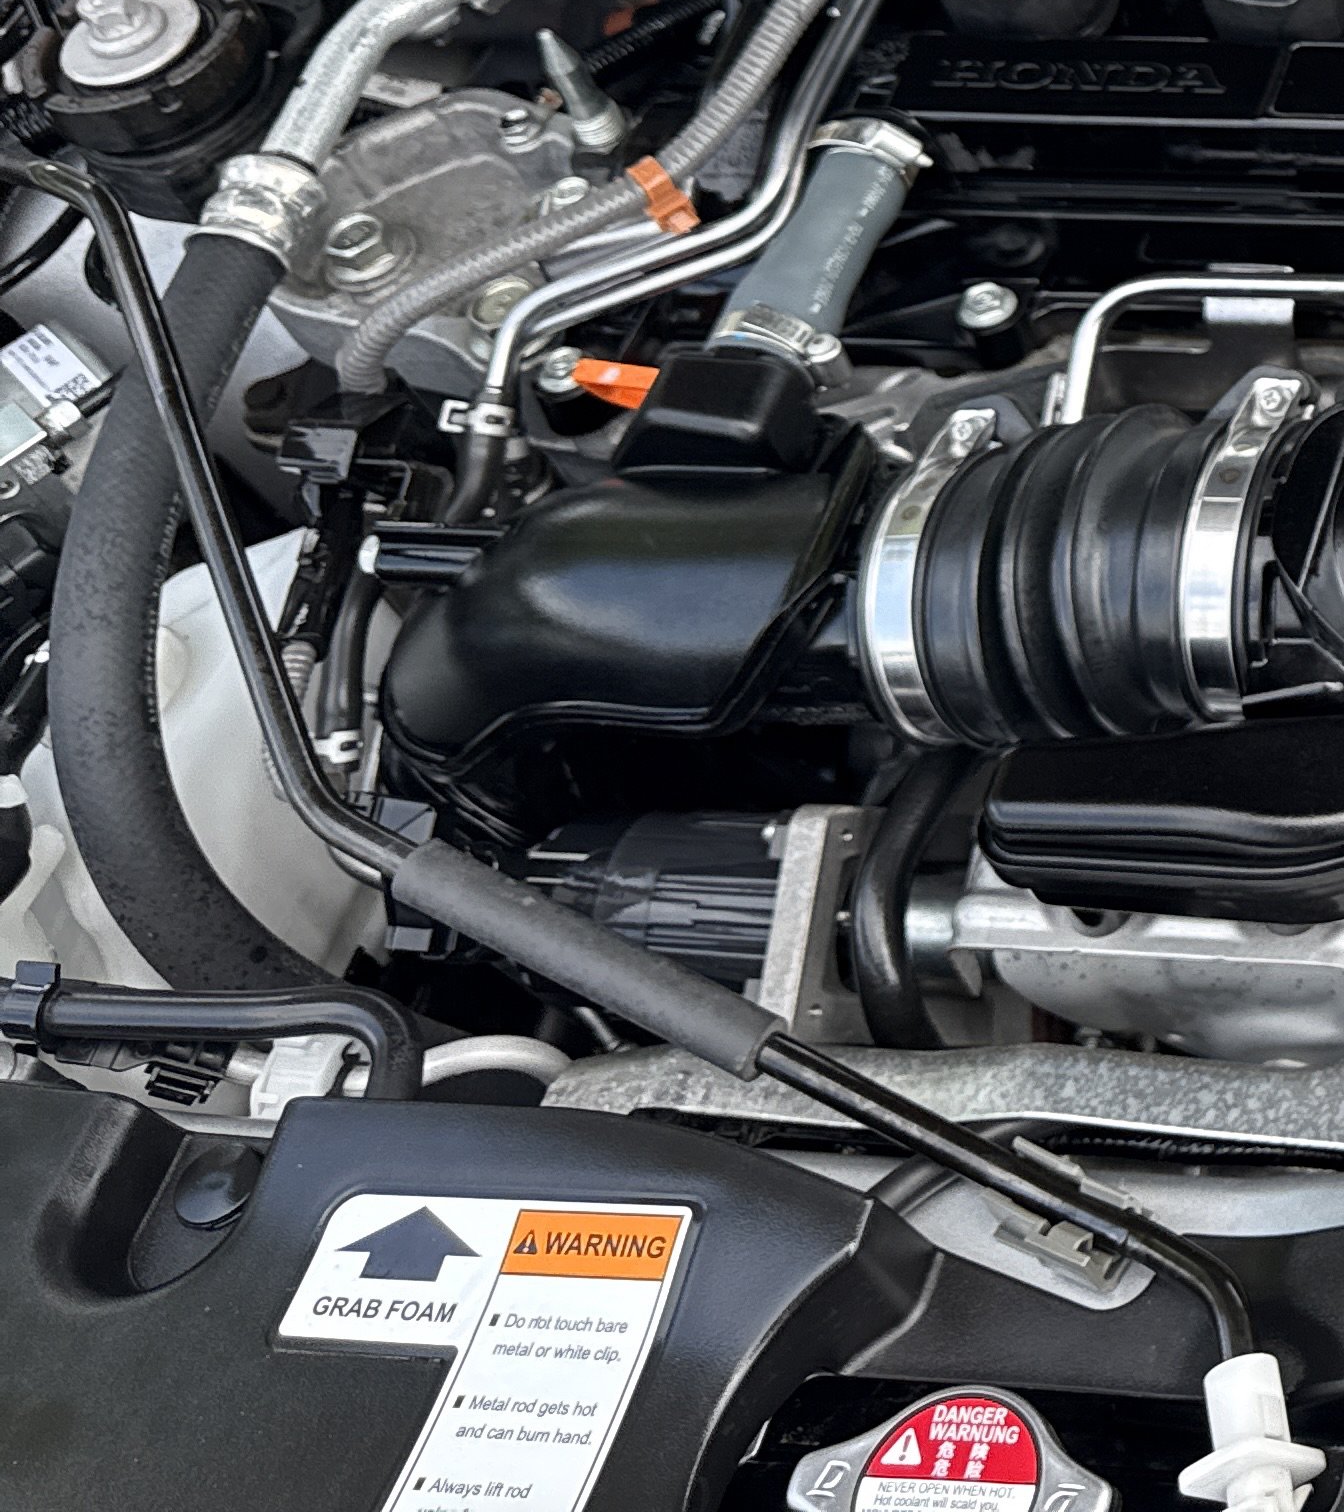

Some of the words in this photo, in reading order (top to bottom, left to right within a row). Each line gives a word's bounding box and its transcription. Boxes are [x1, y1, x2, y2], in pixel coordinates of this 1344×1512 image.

[930, 59, 1227, 95] HONDA
[545, 1232, 667, 1259] WARNING
[312, 1296, 382, 1319] GRAB
[385, 1300, 458, 1323] FOAM
[504, 1314, 529, 1329] Do
[531, 1315, 552, 1331] not
[553, 1316, 593, 1332] touch
[595, 1317, 629, 1334] bare
[492, 1342, 532, 1357] metal
[535, 1345, 550, 1358] or
[553, 1344, 591, 1361] white
[593, 1346, 622, 1364] clip.
[468, 1396, 509, 1413] Metal
[511, 1398, 534, 1414] rod
[536, 1401, 569, 1418] gets
[572, 1401, 599, 1417] hot
[933, 1405, 1008, 1425] DANGER
[455, 1423, 485, 1440] and
[487, 1428, 514, 1442] can
[516, 1426, 550, 1444] burn
[552, 1428, 592, 1446] hand.
[929, 1423, 1020, 1444] WARNUNG
[427, 1477, 481, 1498] Always
[484, 1481, 502, 1497] lift
[504, 1483, 531, 1500] rod
[878, 1481, 916, 1494] NEVER
[918, 1482, 950, 1495] OPEN
[952, 1484, 987, 1497] WHEN
[989, 1486, 1016, 1499] HOT.
[873, 1494, 893, 1506] Hot
[894, 1495, 930, 1507] coolant
[932, 1496, 949, 1508] will
[950, 1497, 978, 1509] scald
